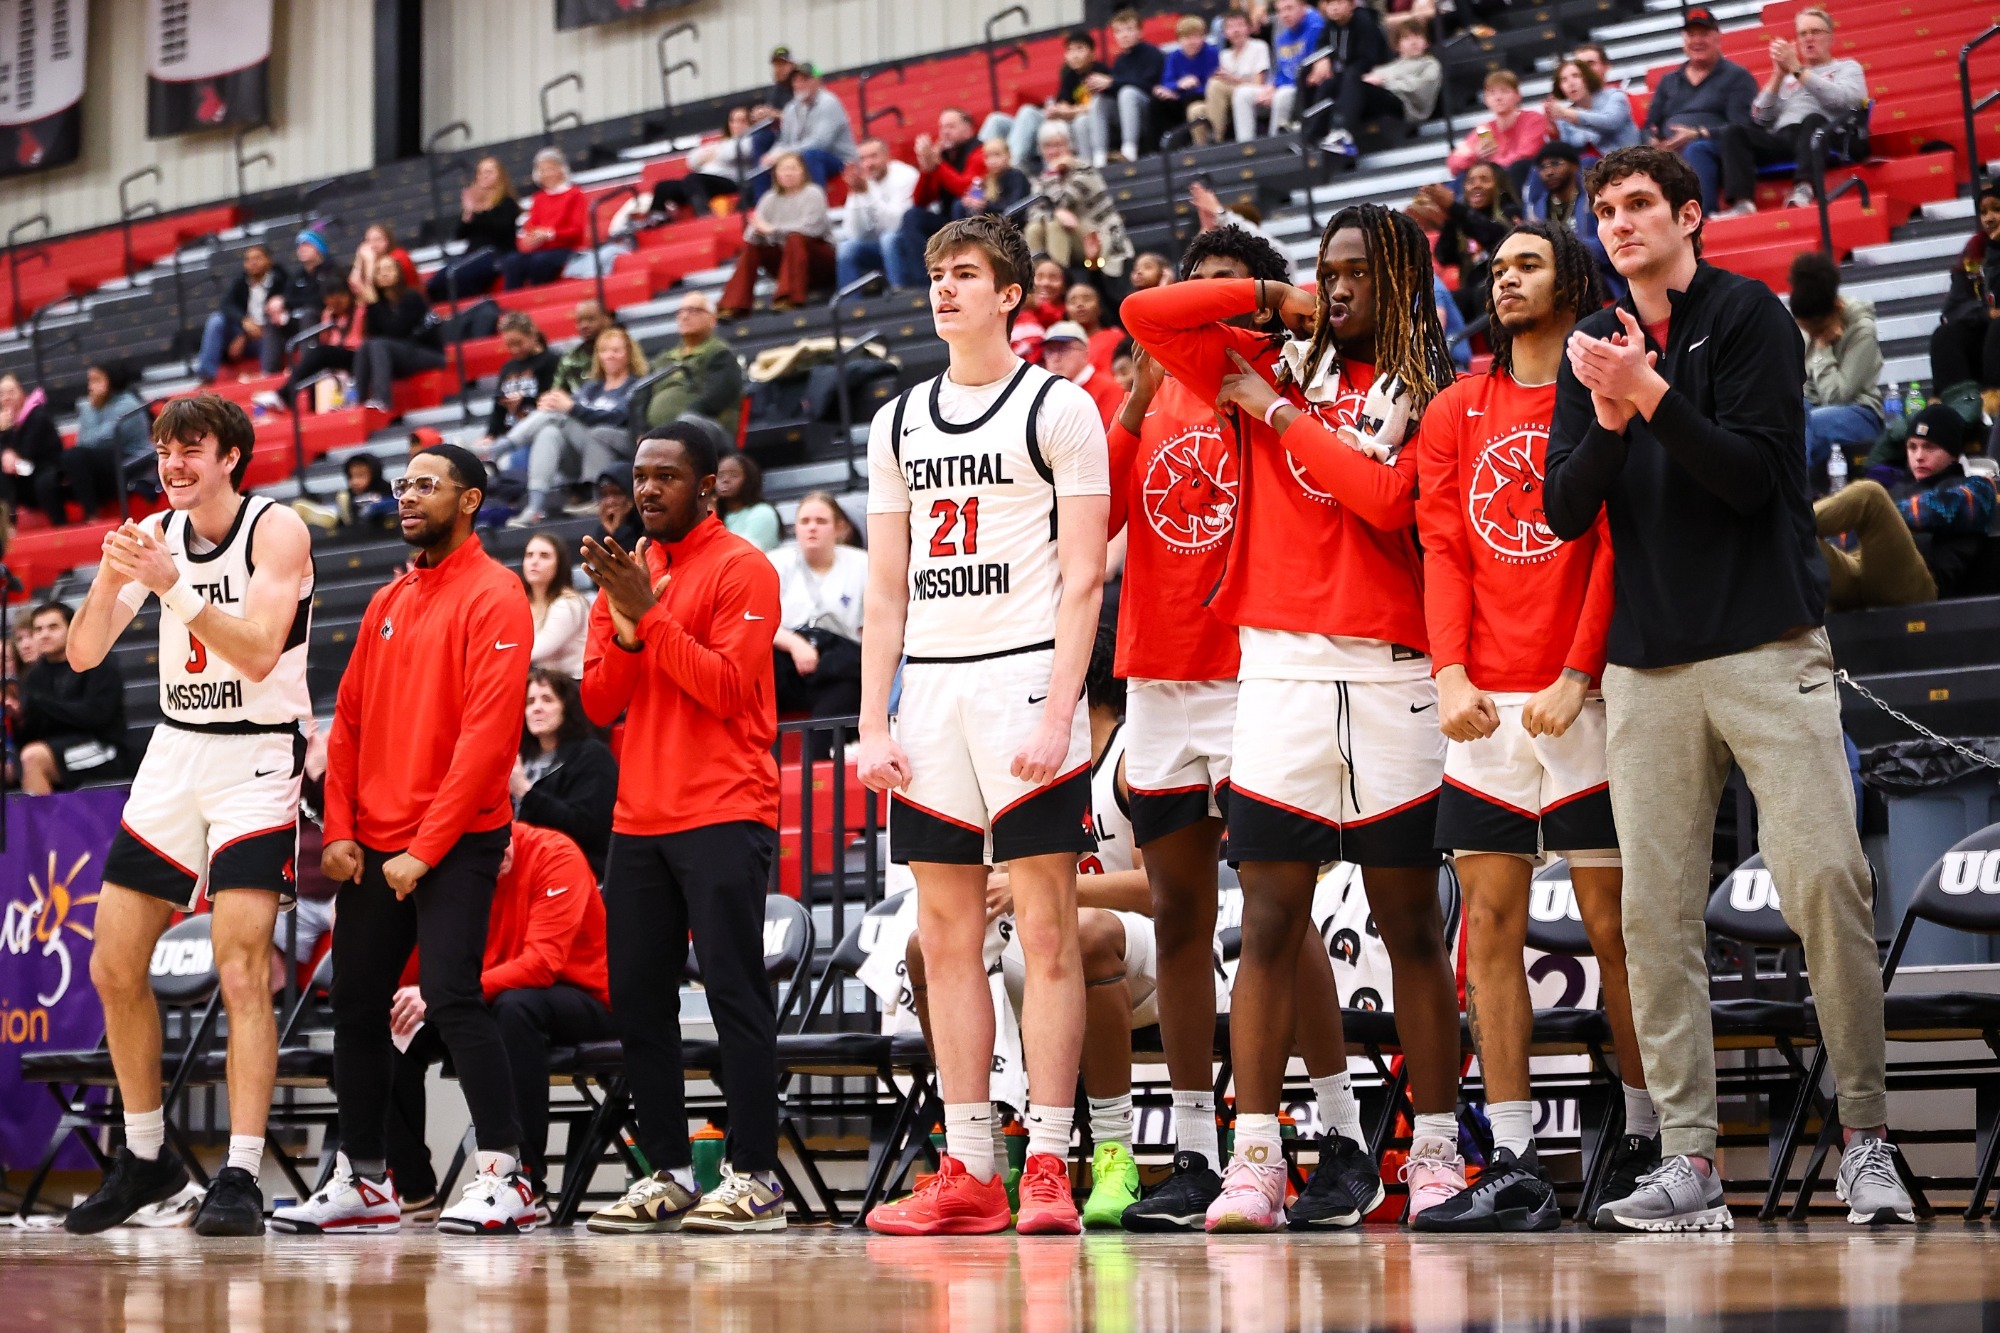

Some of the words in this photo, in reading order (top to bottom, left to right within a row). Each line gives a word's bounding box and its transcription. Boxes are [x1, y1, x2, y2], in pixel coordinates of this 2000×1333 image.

[905, 453, 1014, 492] CENTRAL
[929, 496, 980, 557] 21
[1166, 540, 1223, 556] BASKETBALL
[1494, 551, 1558, 565] BASKETBALL
[913, 563, 1010, 602] MISSOURI
[166, 679, 243, 711] MISSOURI
[0, 998, 49, 1043] ion
